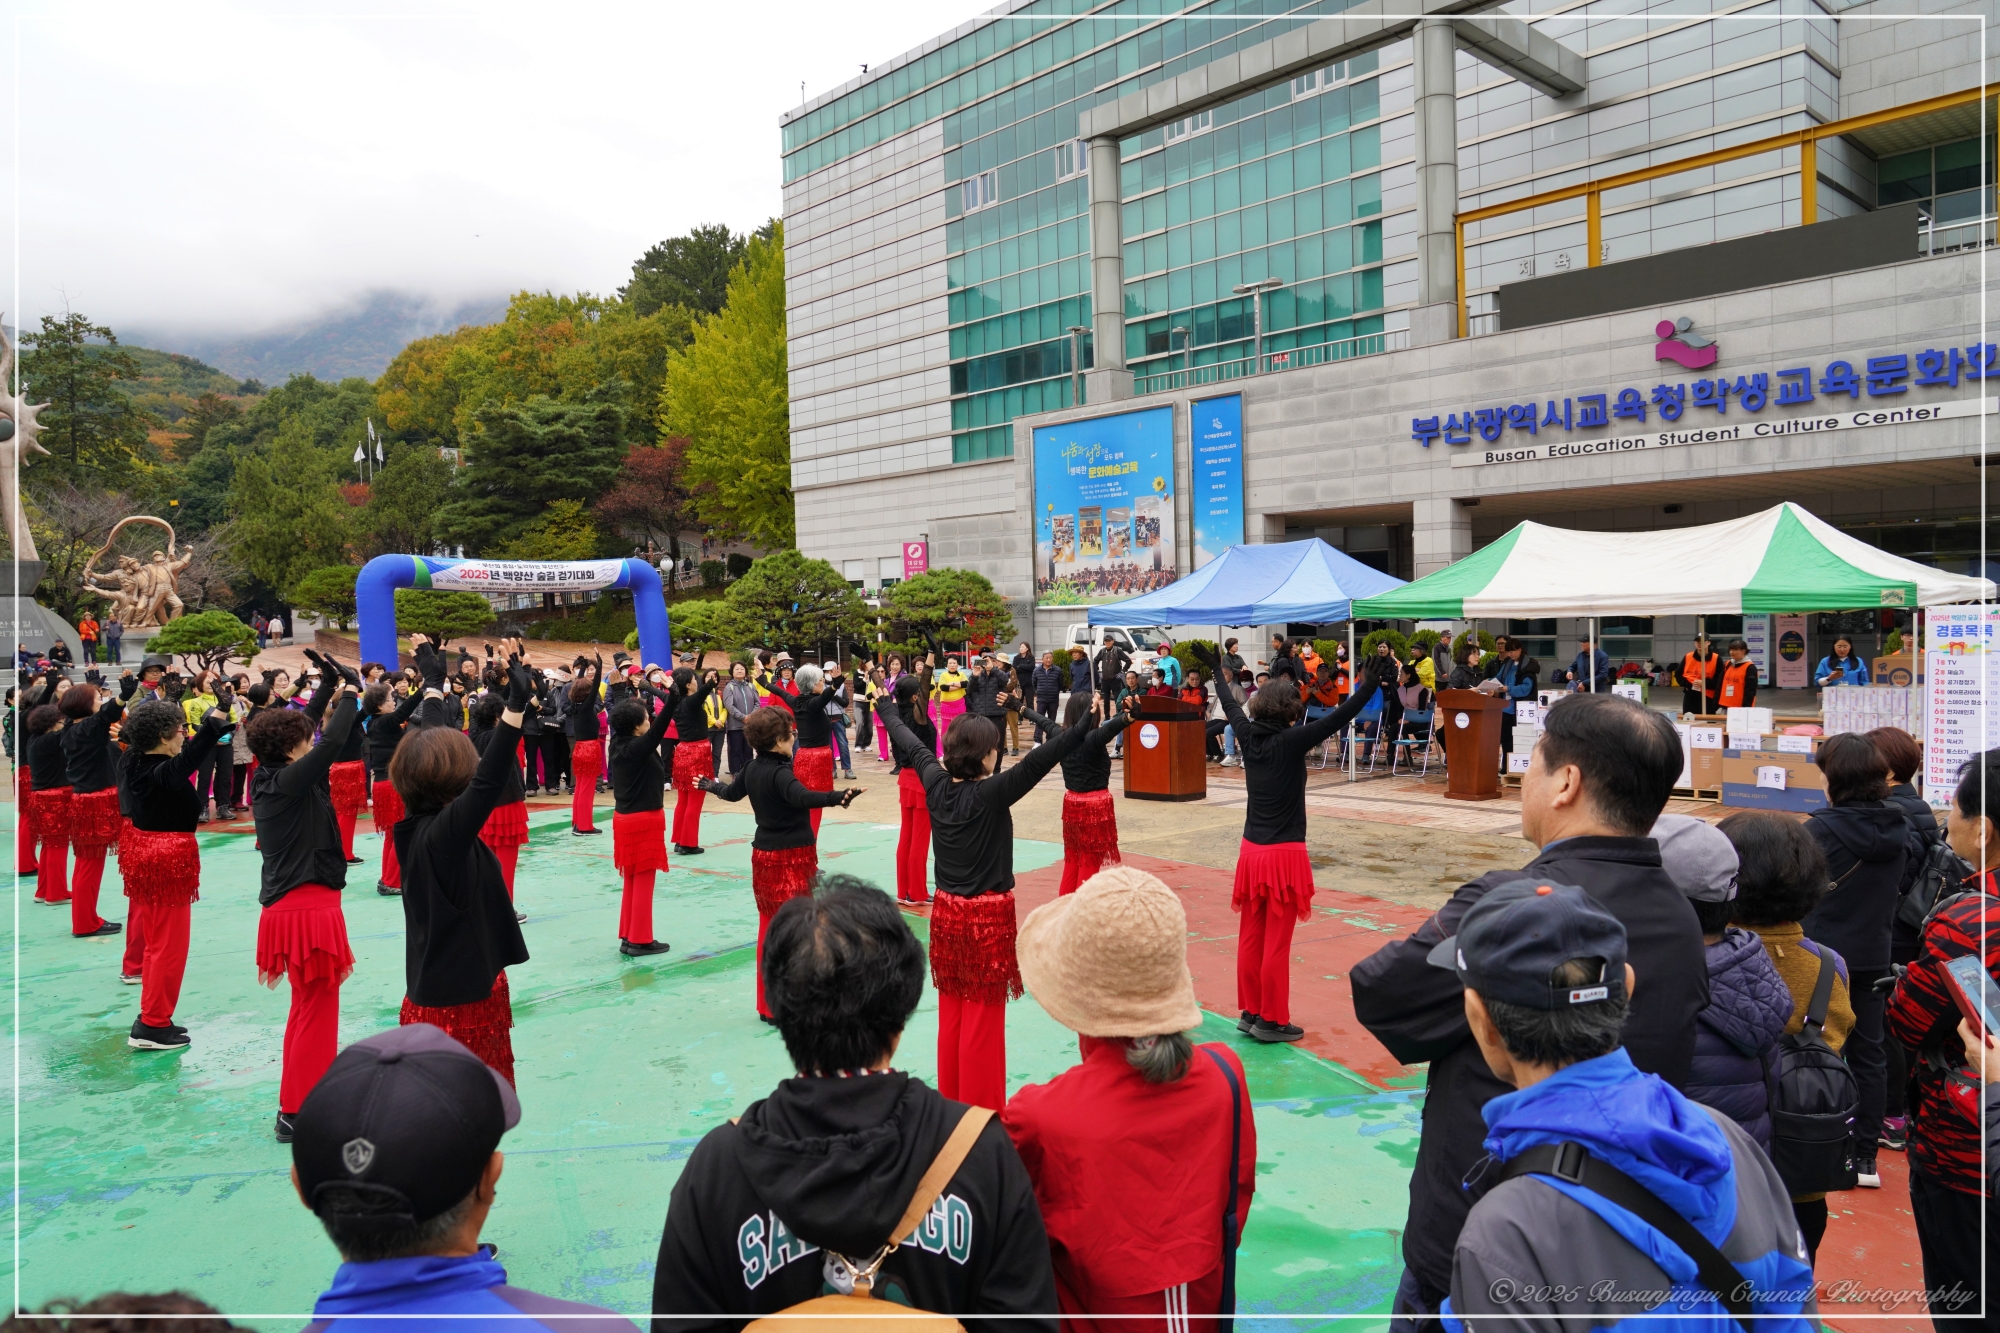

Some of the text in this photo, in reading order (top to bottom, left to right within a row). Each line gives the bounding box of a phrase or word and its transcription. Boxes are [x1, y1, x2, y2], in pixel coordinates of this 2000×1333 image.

[1485, 403, 1942, 463] Busan Education Student Culture Center
[1070, 461, 1139, 479] 행복한 문화예술교육
[460, 568, 595, 582] 2025년 백양산 숲길 걷기대회
[1936, 624, 1993, 638] 경품목록
[1627, 690, 1635, 699] 등
[1528, 709, 1535, 718] 등
[1696, 733, 1716, 742] 2 등
[1522, 760, 1529, 768] 등
[1774, 773, 1781, 782] 등
